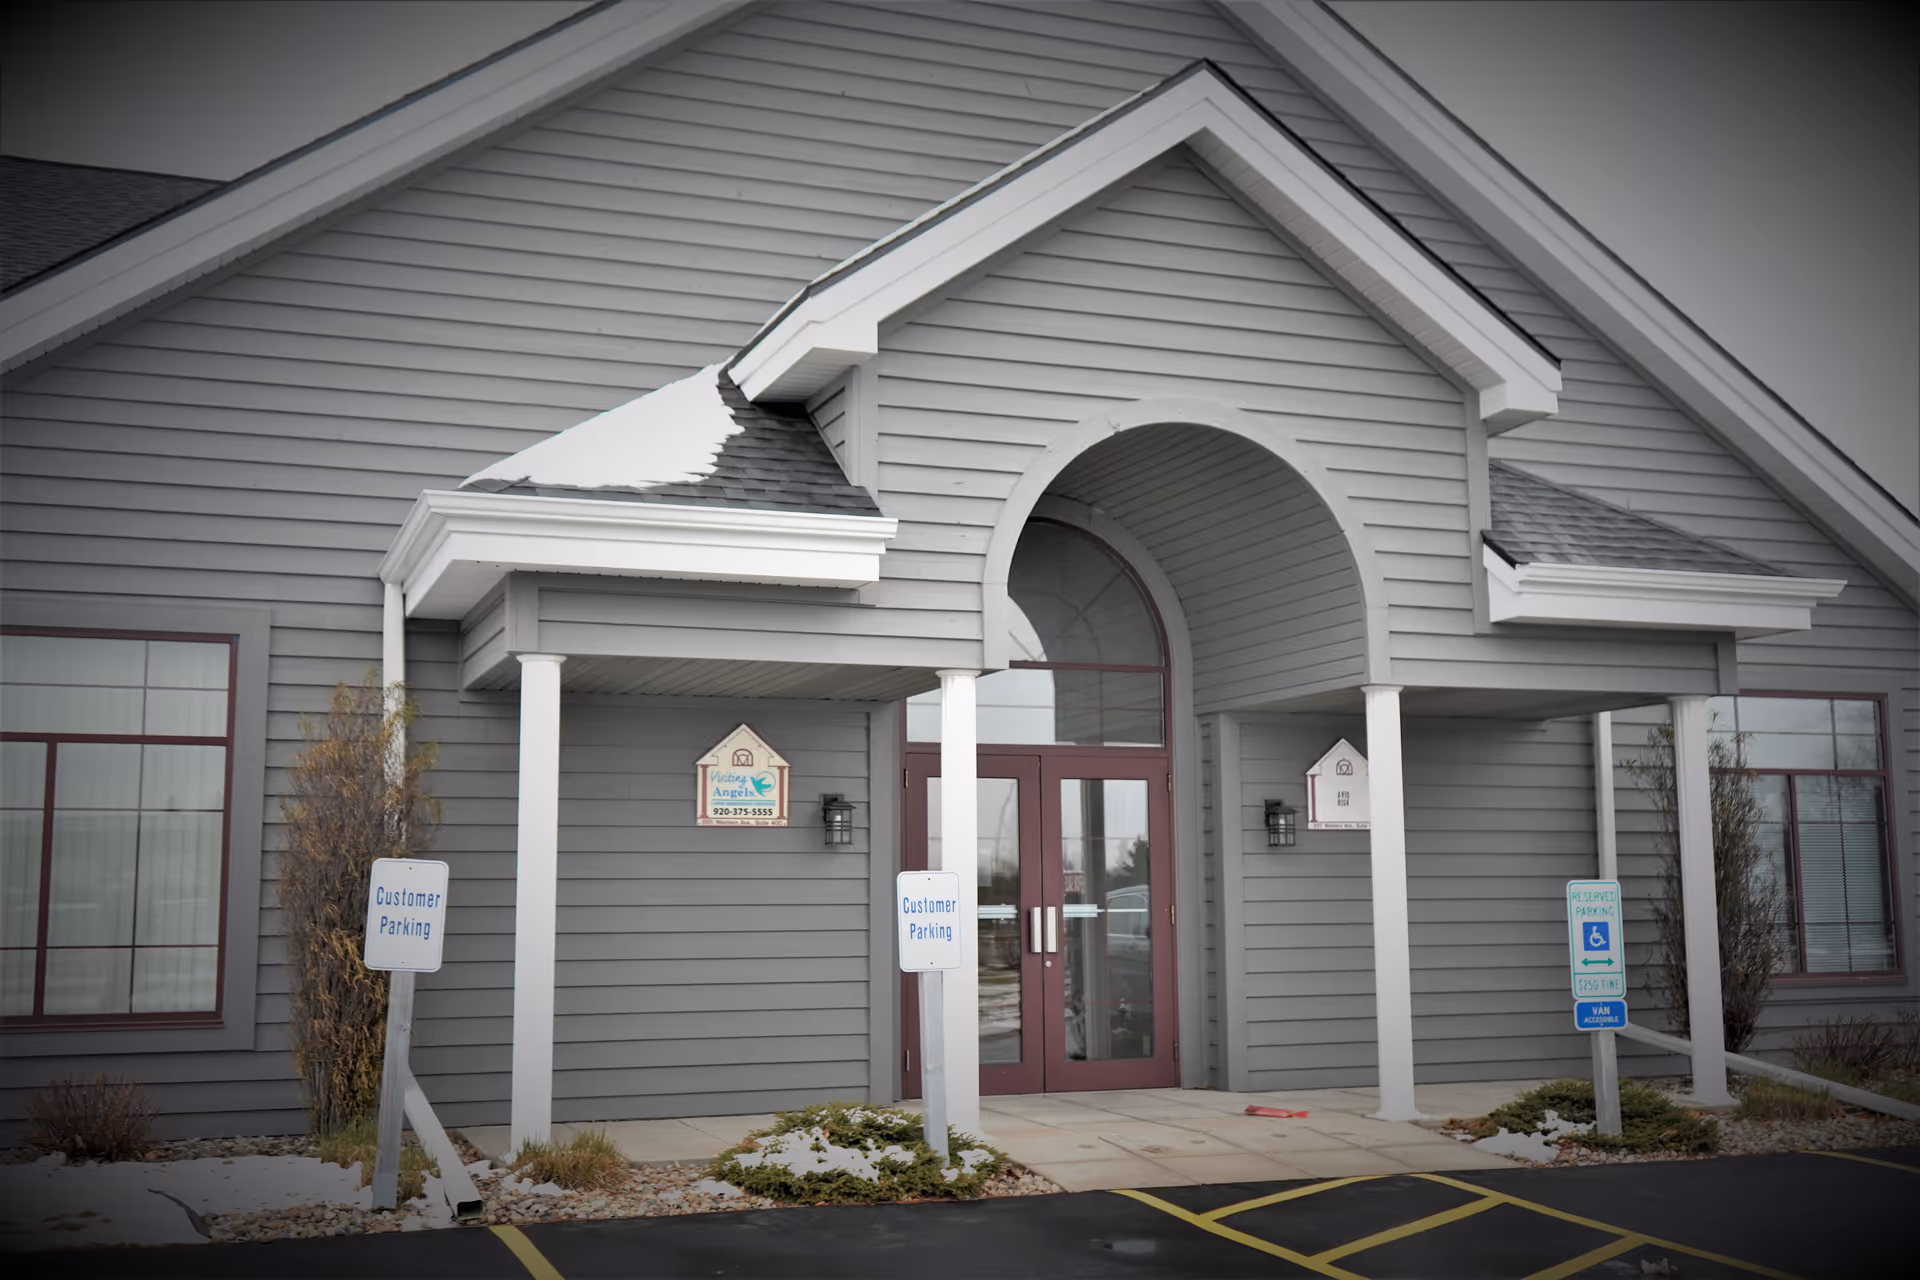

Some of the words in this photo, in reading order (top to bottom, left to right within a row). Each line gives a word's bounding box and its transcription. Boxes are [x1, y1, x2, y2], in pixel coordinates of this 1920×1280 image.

[711, 769, 749, 789] Visiting
[713, 787, 754, 798] Angels
[713, 808, 773, 816] 920-375-5555
[376, 886, 441, 908] Customer
[1571, 891, 1616, 902] RESERVED
[903, 896, 956, 914] Customer
[1576, 905, 1614, 917] PARKING
[380, 915, 431, 940] Parking
[910, 922, 952, 942] Parking
[1578, 979, 1599, 991] $250
[1602, 978, 1619, 990] FINE
[1592, 1006, 1610, 1015] VAN
